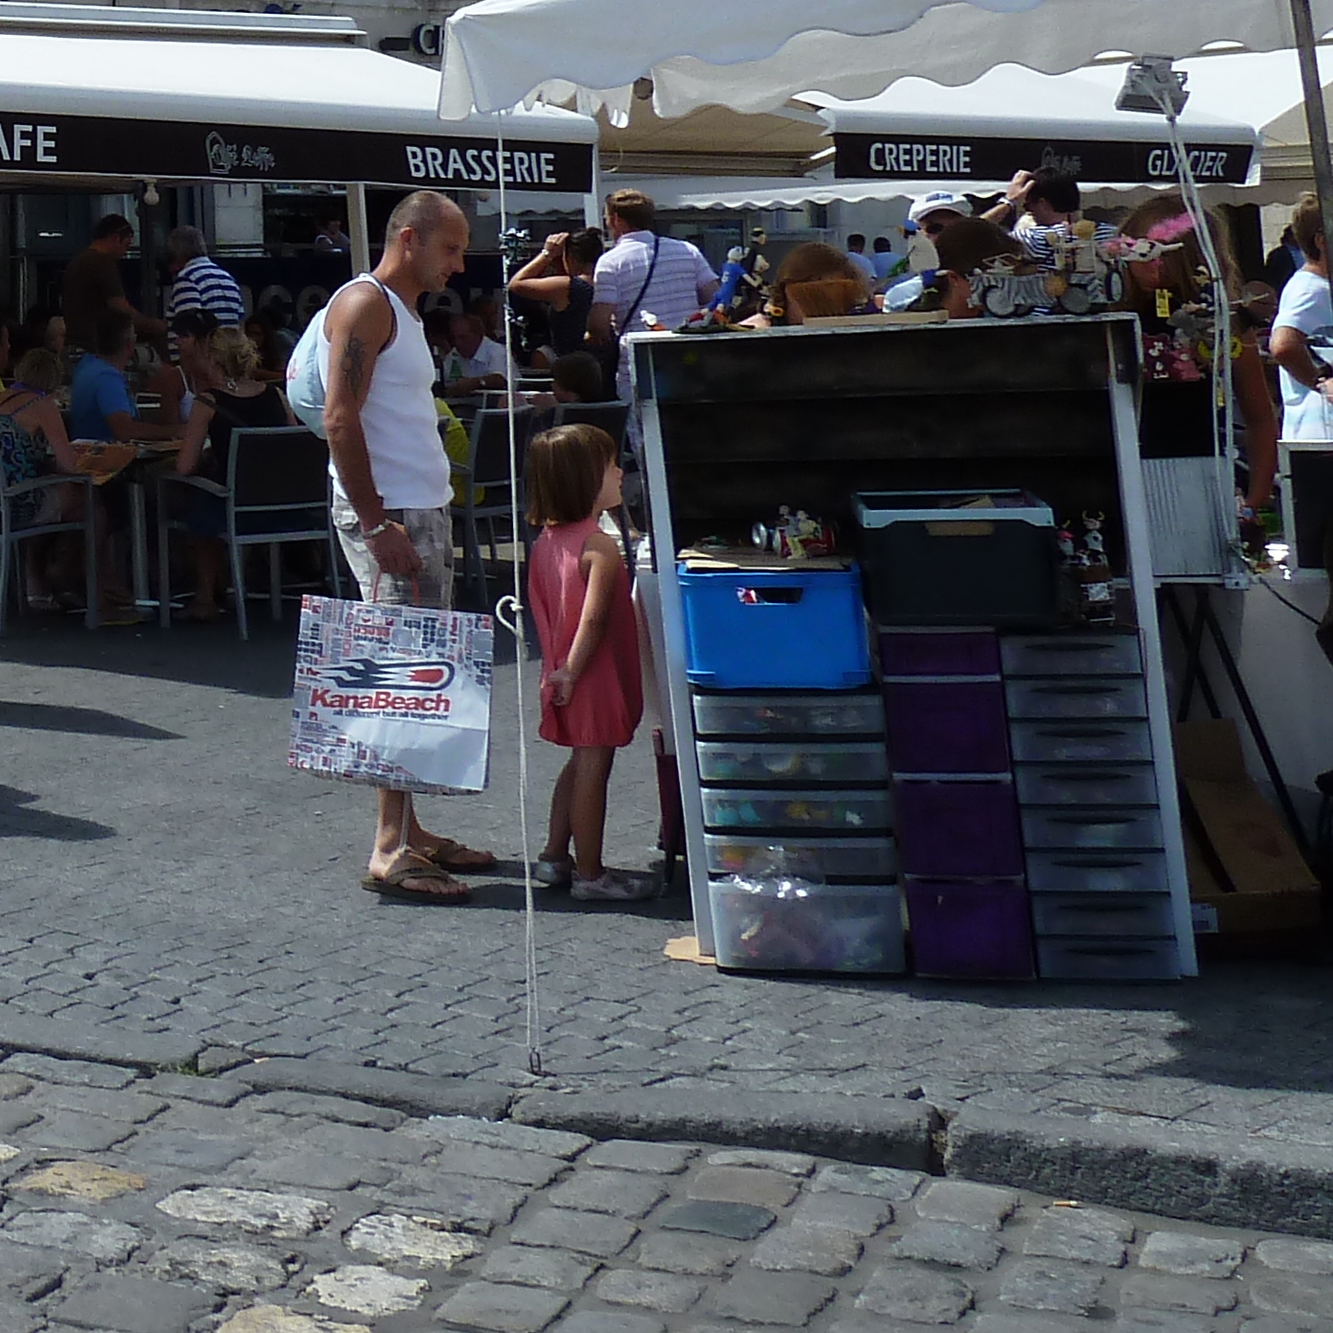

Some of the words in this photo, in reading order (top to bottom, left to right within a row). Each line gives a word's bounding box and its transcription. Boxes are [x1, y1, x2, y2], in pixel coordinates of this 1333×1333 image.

[405, 145, 557, 184] BRASSERIE
[869, 143, 972, 173] CREPERIE
[310, 688, 451, 713] KanaBeach
